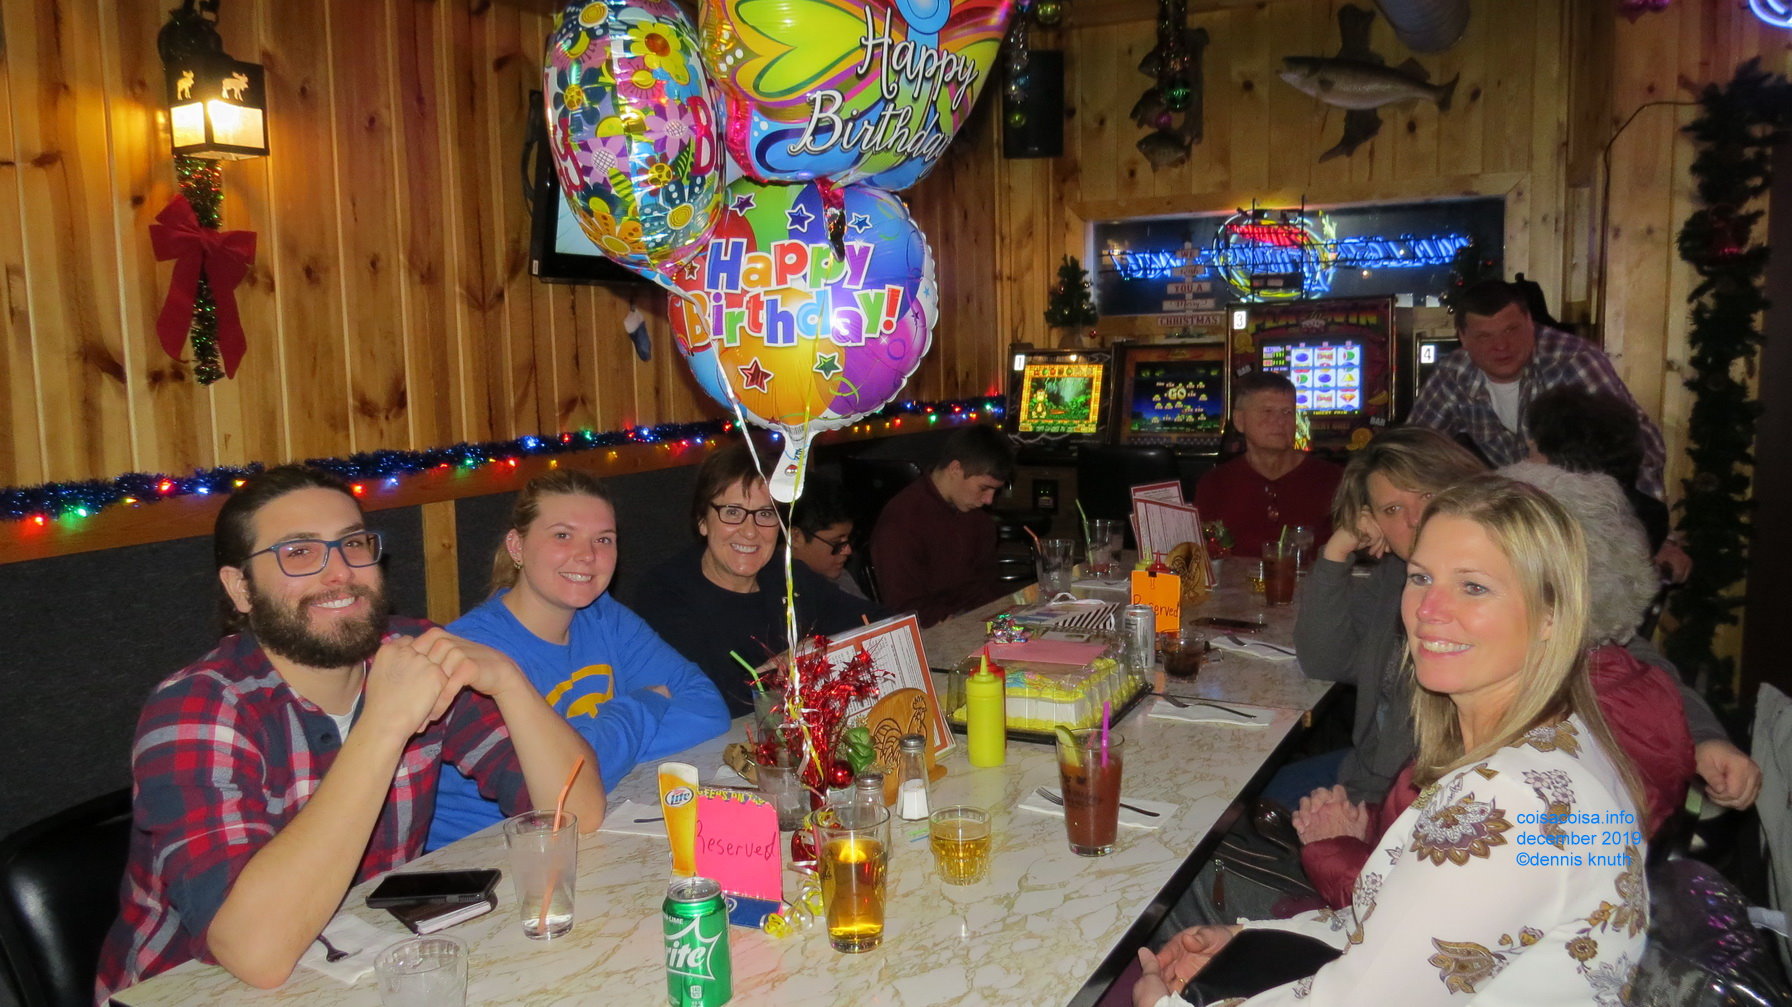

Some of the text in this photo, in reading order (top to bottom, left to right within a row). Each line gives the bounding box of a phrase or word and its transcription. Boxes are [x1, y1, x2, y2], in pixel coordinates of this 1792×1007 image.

[856, 4, 979, 111] Happy
[705, 239, 874, 294] Happy
[1174, 285, 1192, 294] YOU
[681, 285, 904, 348] Birthday!
[1158, 315, 1218, 327] CHRISTMAS
[1236, 312, 1244, 327] 3
[1423, 347, 1432, 361] 4
[1133, 594, 1180, 617] Rerved
[670, 792, 690, 806] Lite
[665, 940, 706, 968] rite
